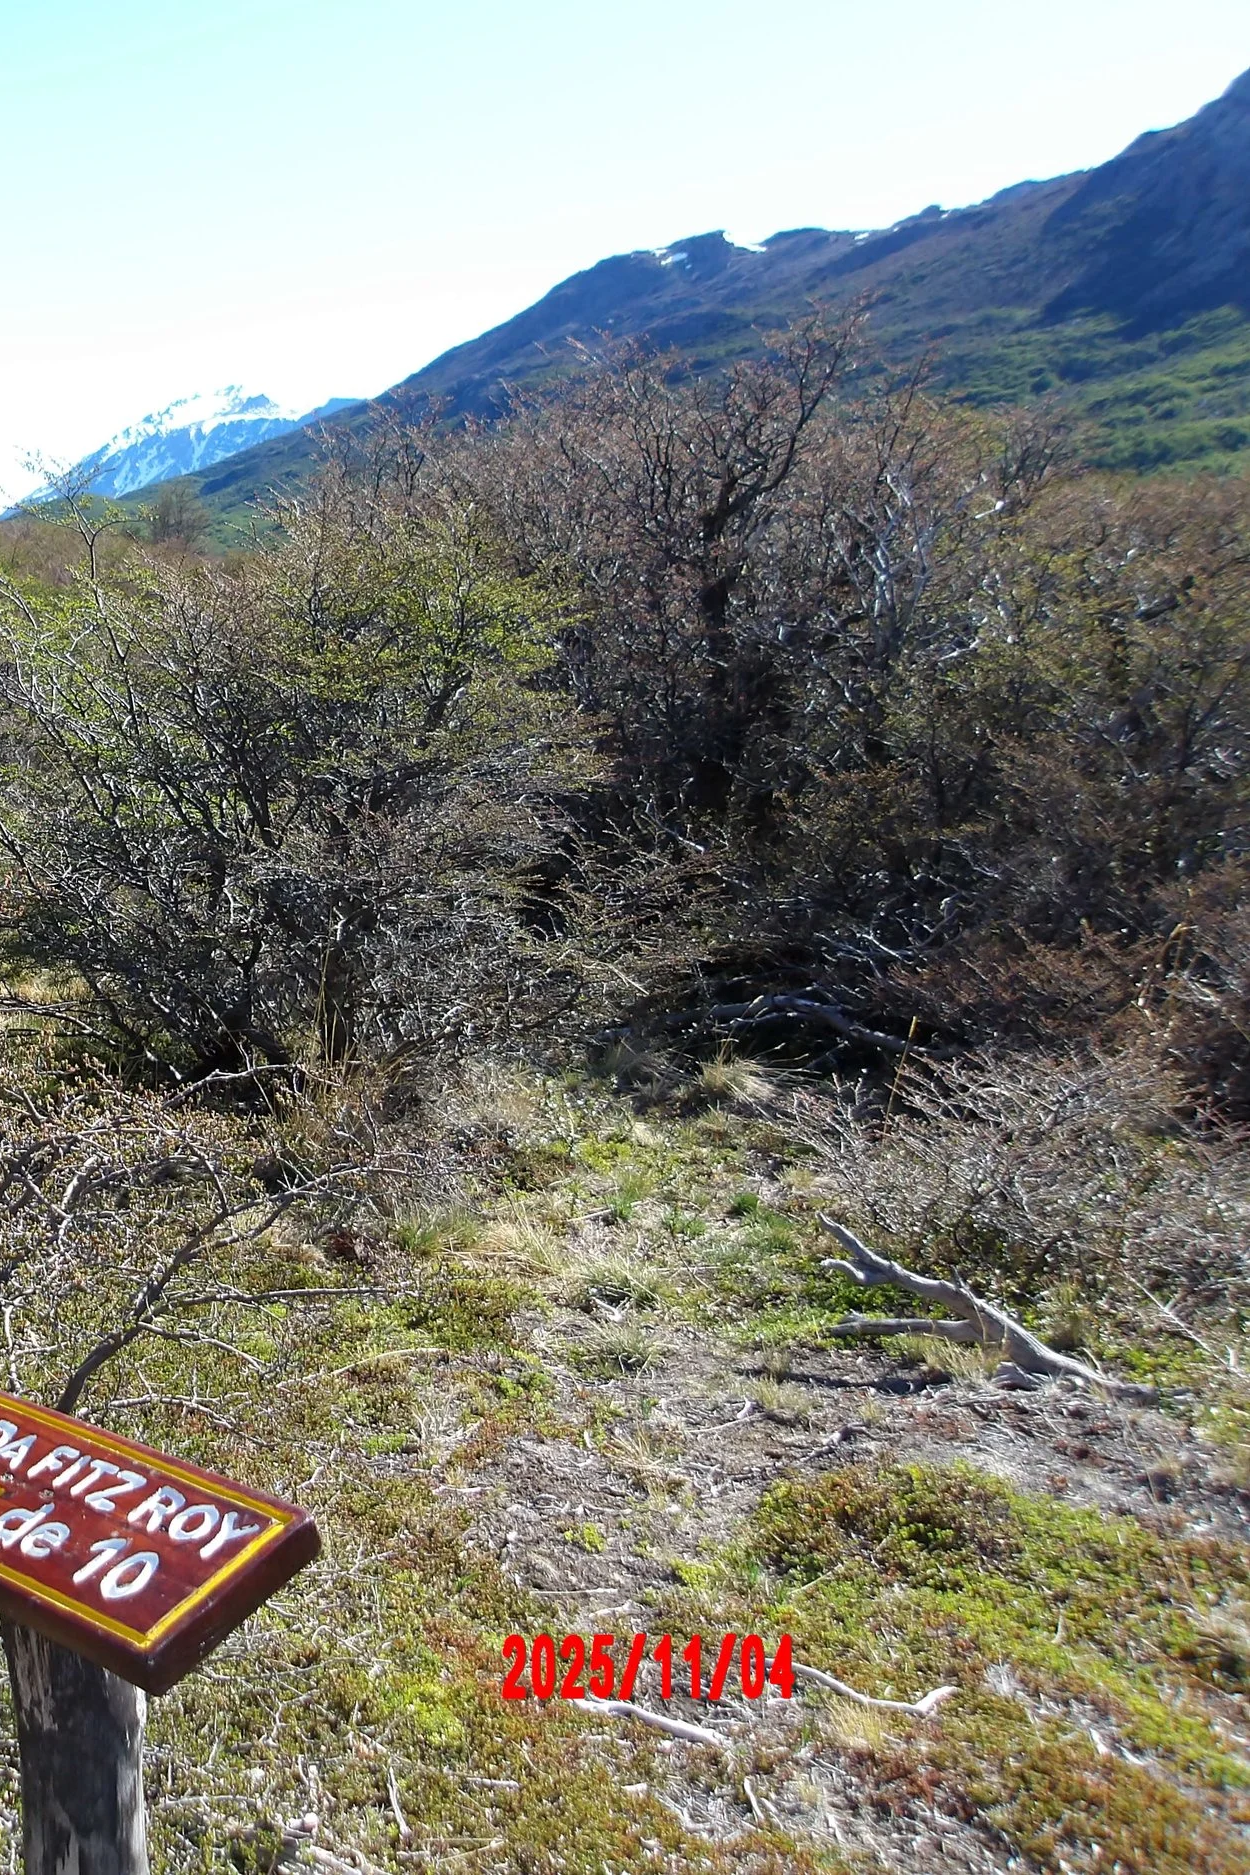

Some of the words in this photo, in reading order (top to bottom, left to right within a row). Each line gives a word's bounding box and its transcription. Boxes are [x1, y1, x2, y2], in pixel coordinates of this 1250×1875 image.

[26, 1445, 148, 1512] FITZ
[127, 1486, 260, 1560] ROY
[72, 1537, 160, 1600] 10
